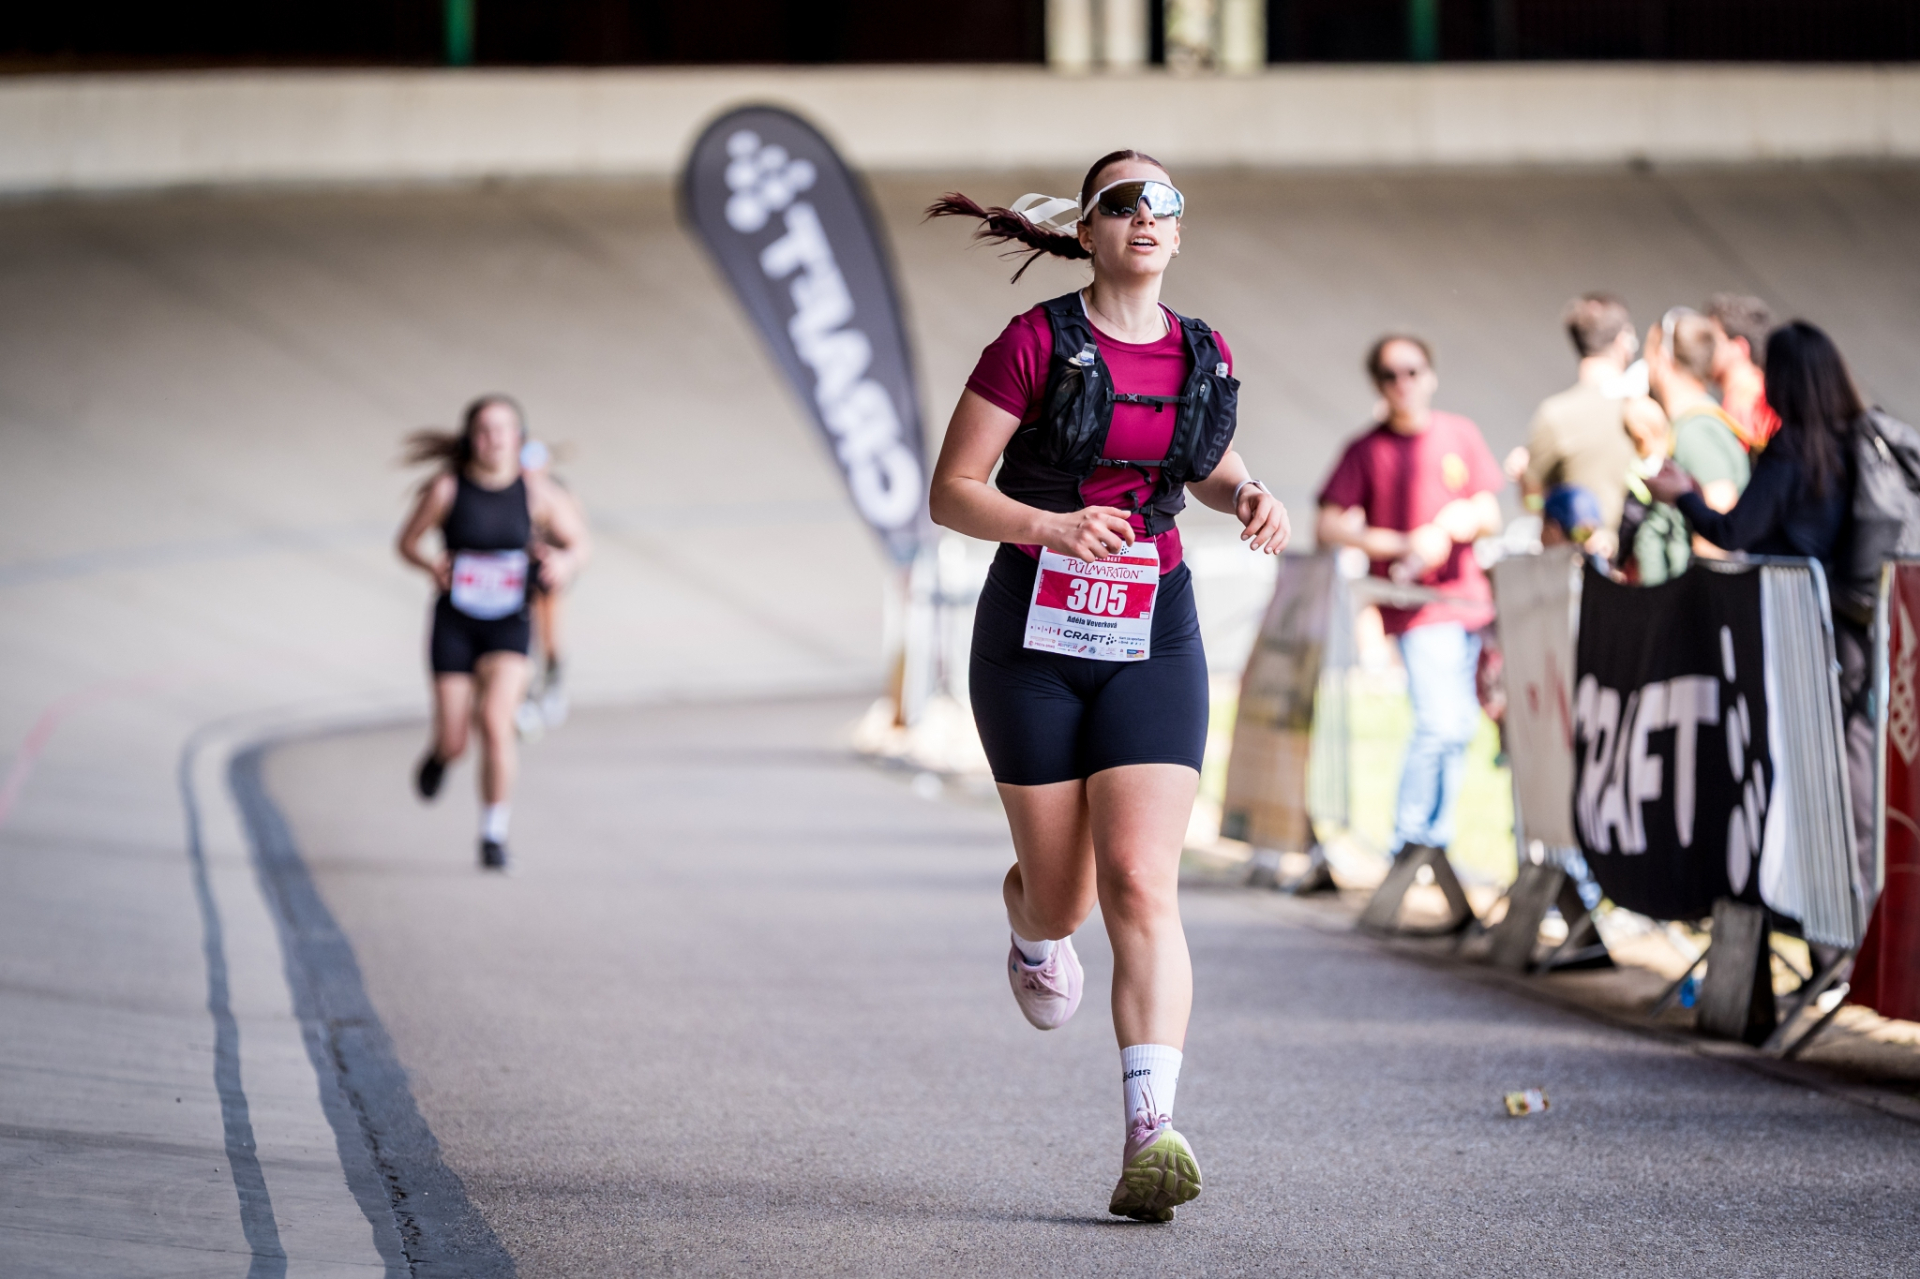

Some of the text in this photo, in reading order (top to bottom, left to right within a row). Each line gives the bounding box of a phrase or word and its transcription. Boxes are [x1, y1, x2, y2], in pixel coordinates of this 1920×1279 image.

[1200, 395, 1237, 474] IPRUN
[1066, 578, 1128, 616] 305
[1063, 629, 1107, 644] CRAFT
